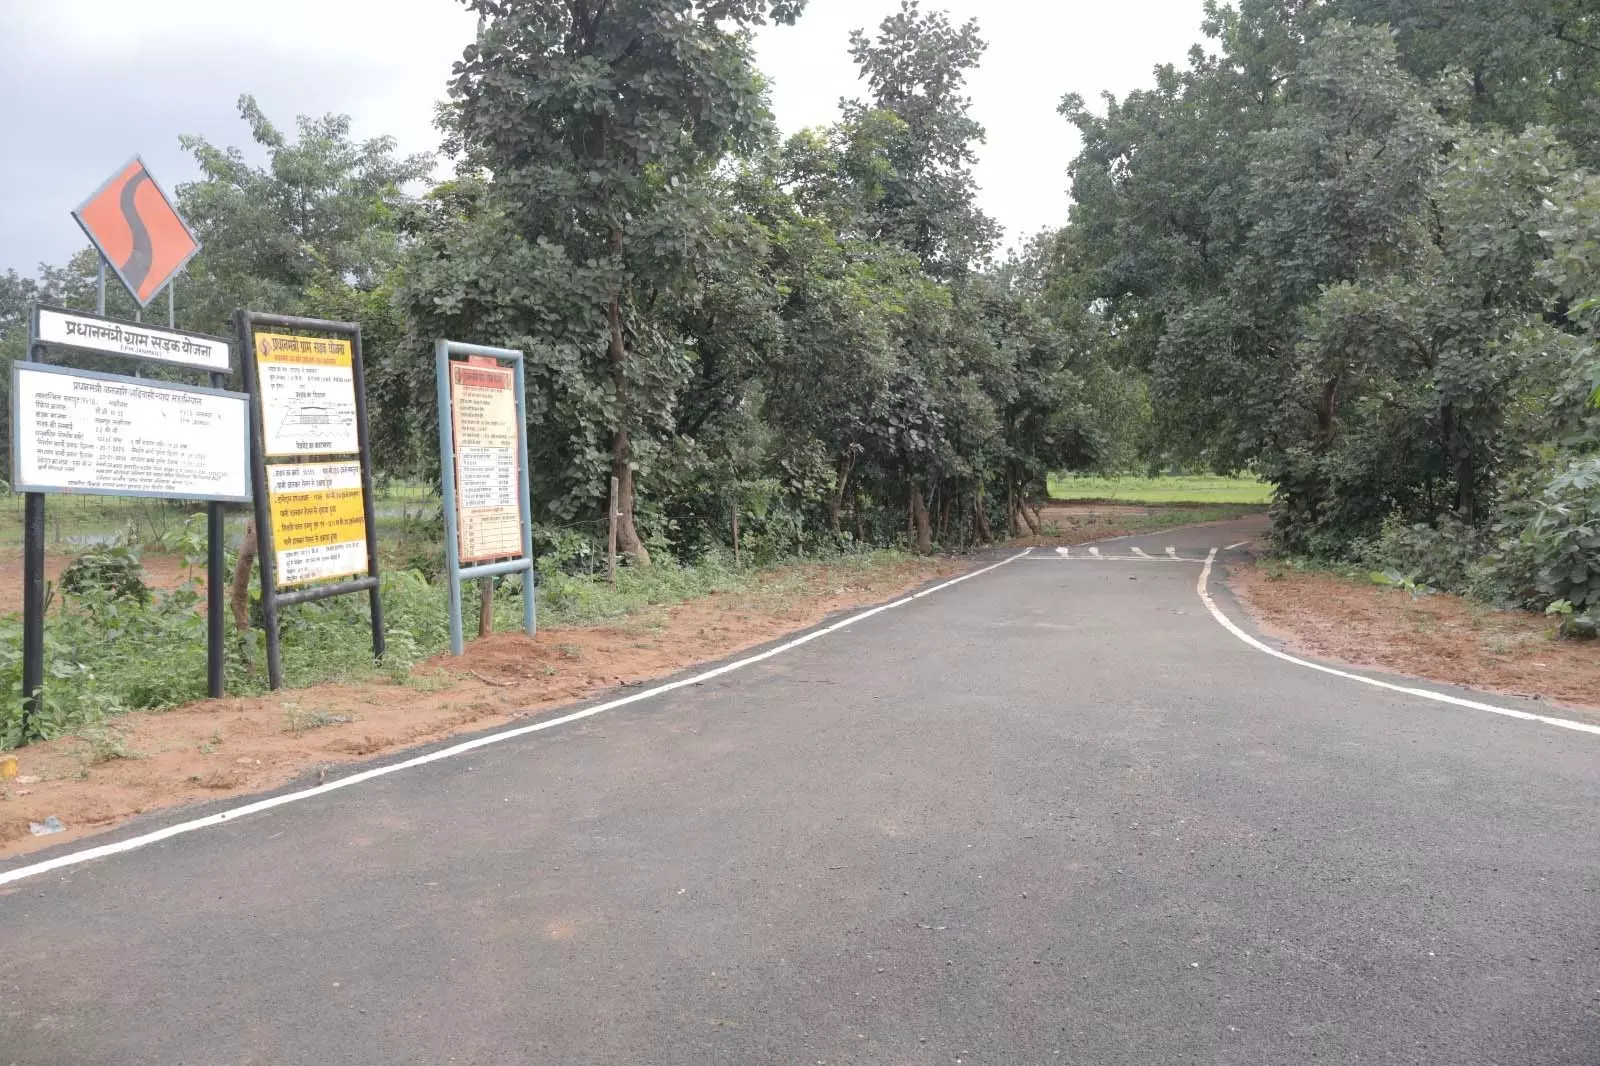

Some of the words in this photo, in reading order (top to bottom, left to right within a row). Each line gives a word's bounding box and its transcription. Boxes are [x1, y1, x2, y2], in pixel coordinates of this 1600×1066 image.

[65, 320, 122, 343] प्रधानमंत्री
[124, 331, 149, 347] ग्राम
[150, 336, 181, 354] सड़क
[181, 337, 212, 358] योजना
